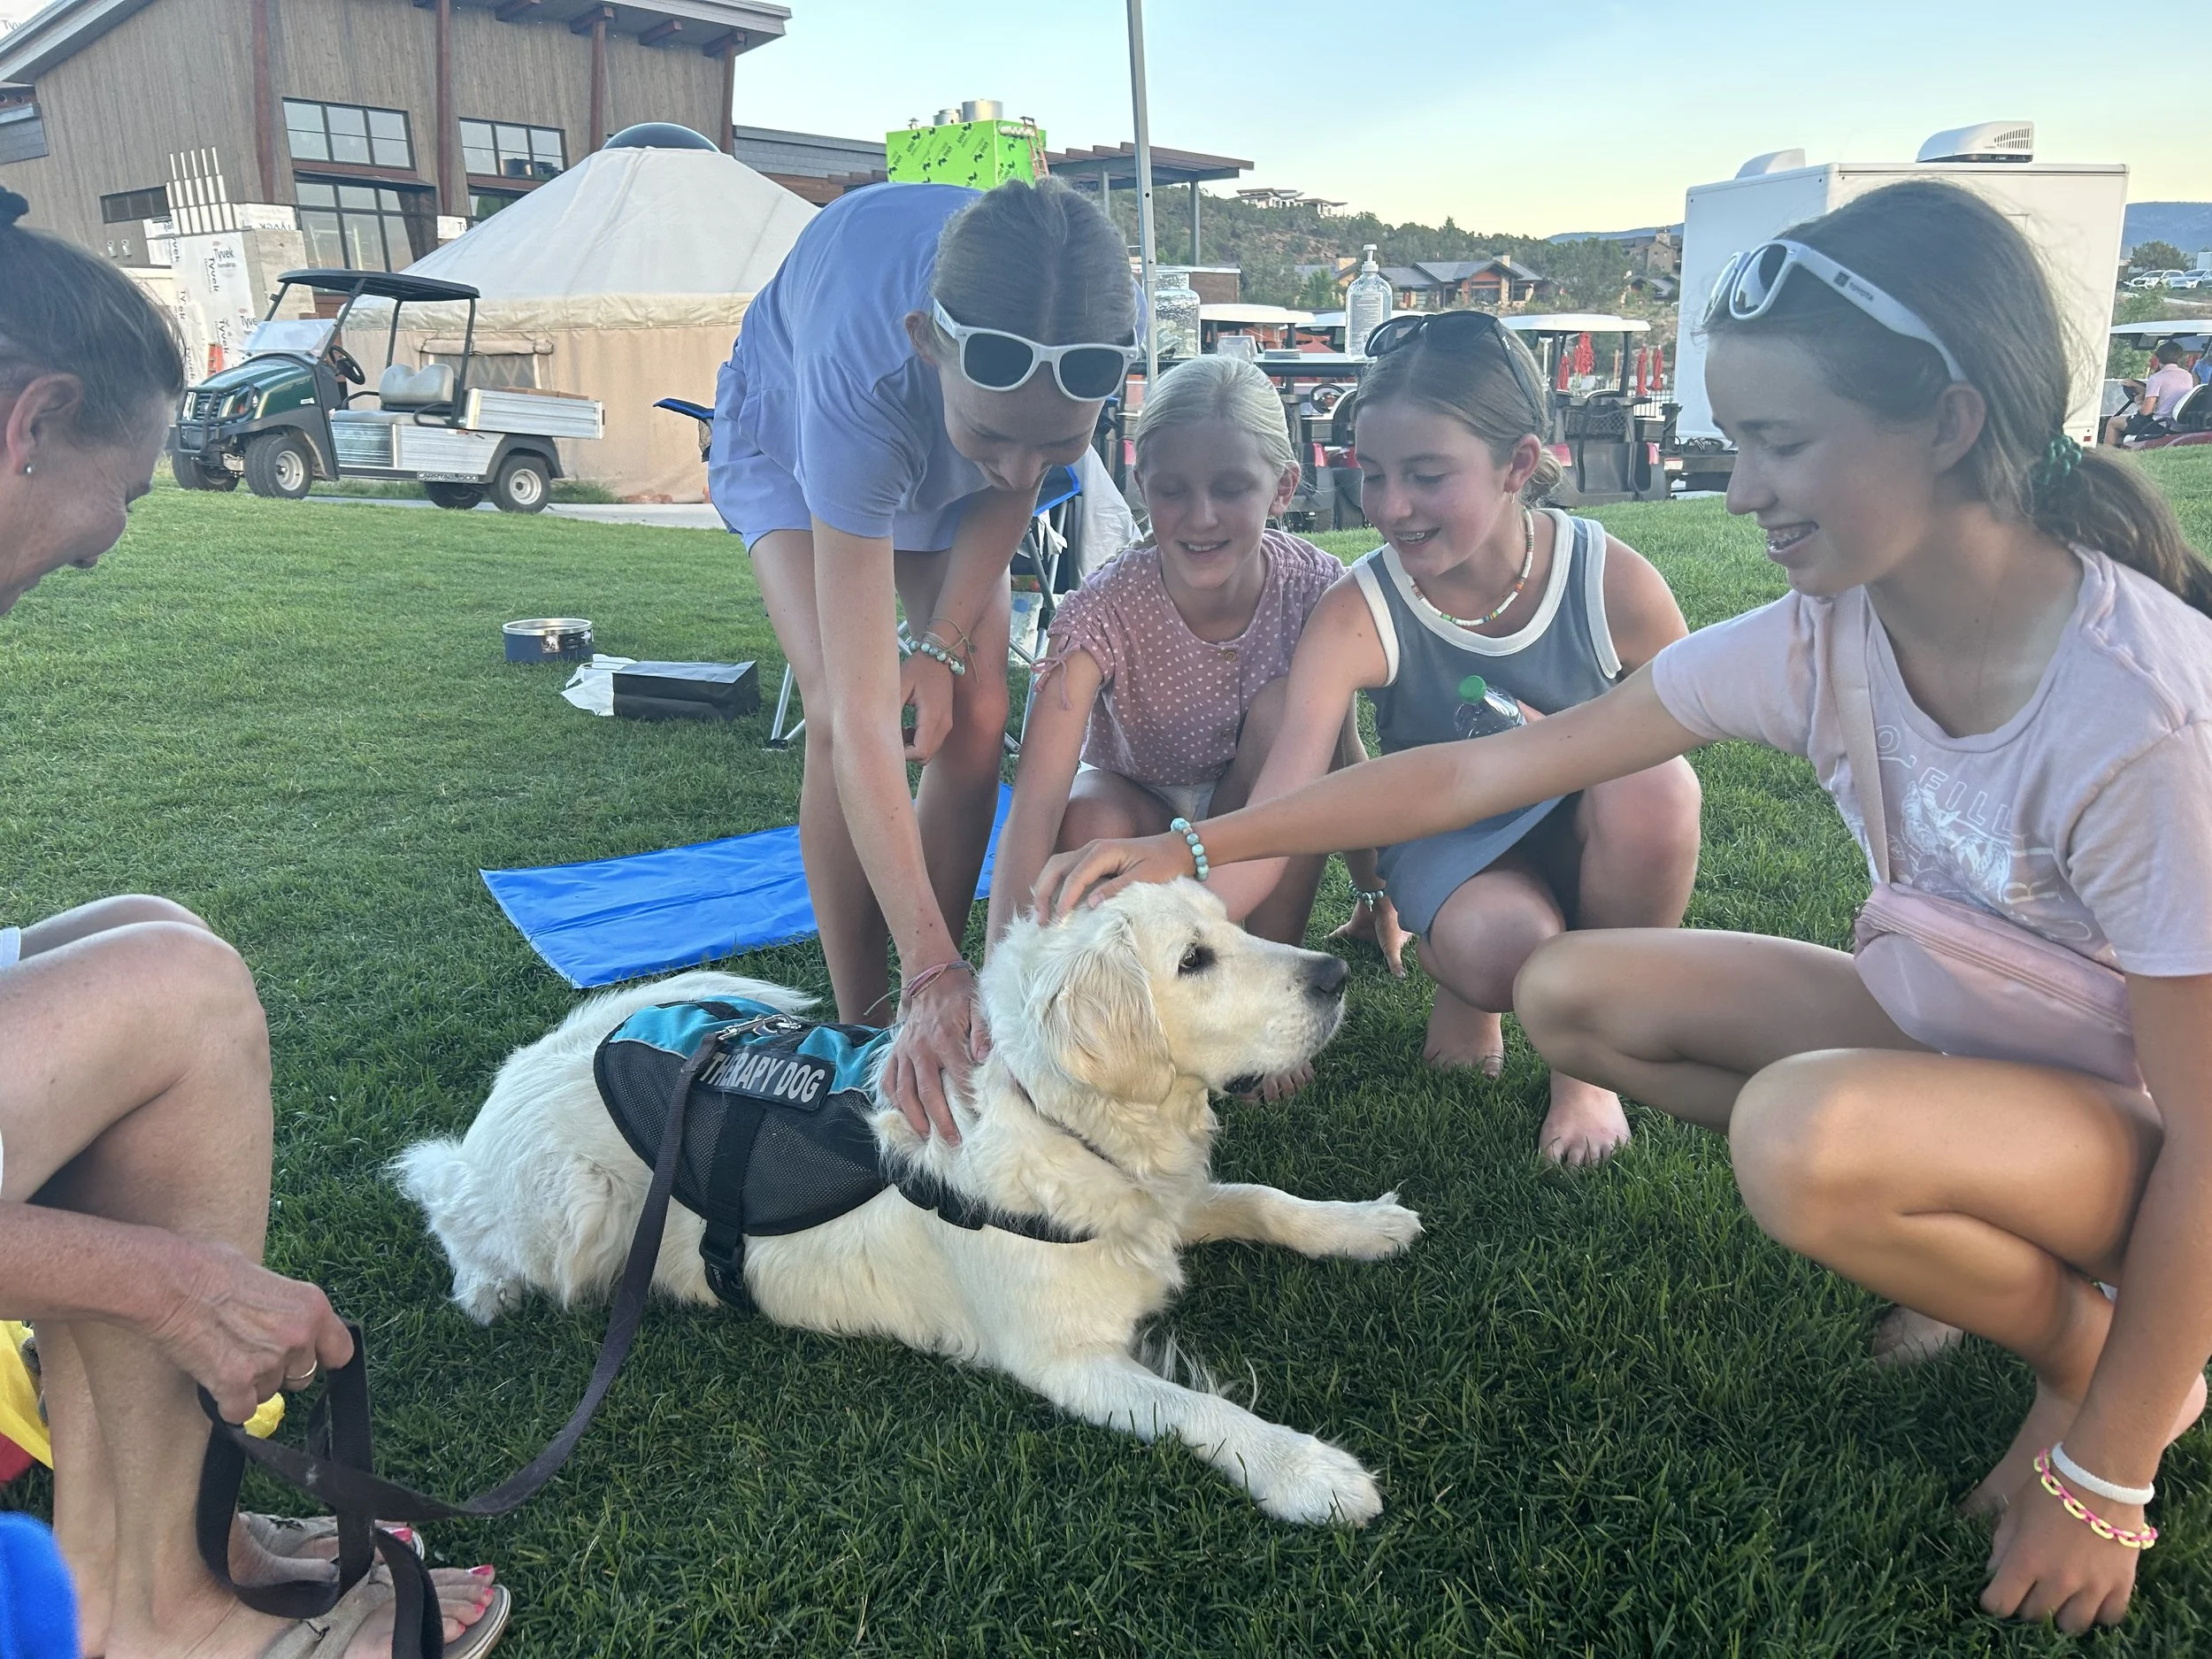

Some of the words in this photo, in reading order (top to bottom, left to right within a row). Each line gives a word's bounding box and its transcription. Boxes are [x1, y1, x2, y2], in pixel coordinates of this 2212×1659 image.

[213, 248, 234, 262] Tyvek
[209, 257, 219, 292] Tyvek
[219, 320, 229, 354] Tyvek
[700, 1052, 785, 1093] THERAPY
[773, 1062, 826, 1102] DOG
